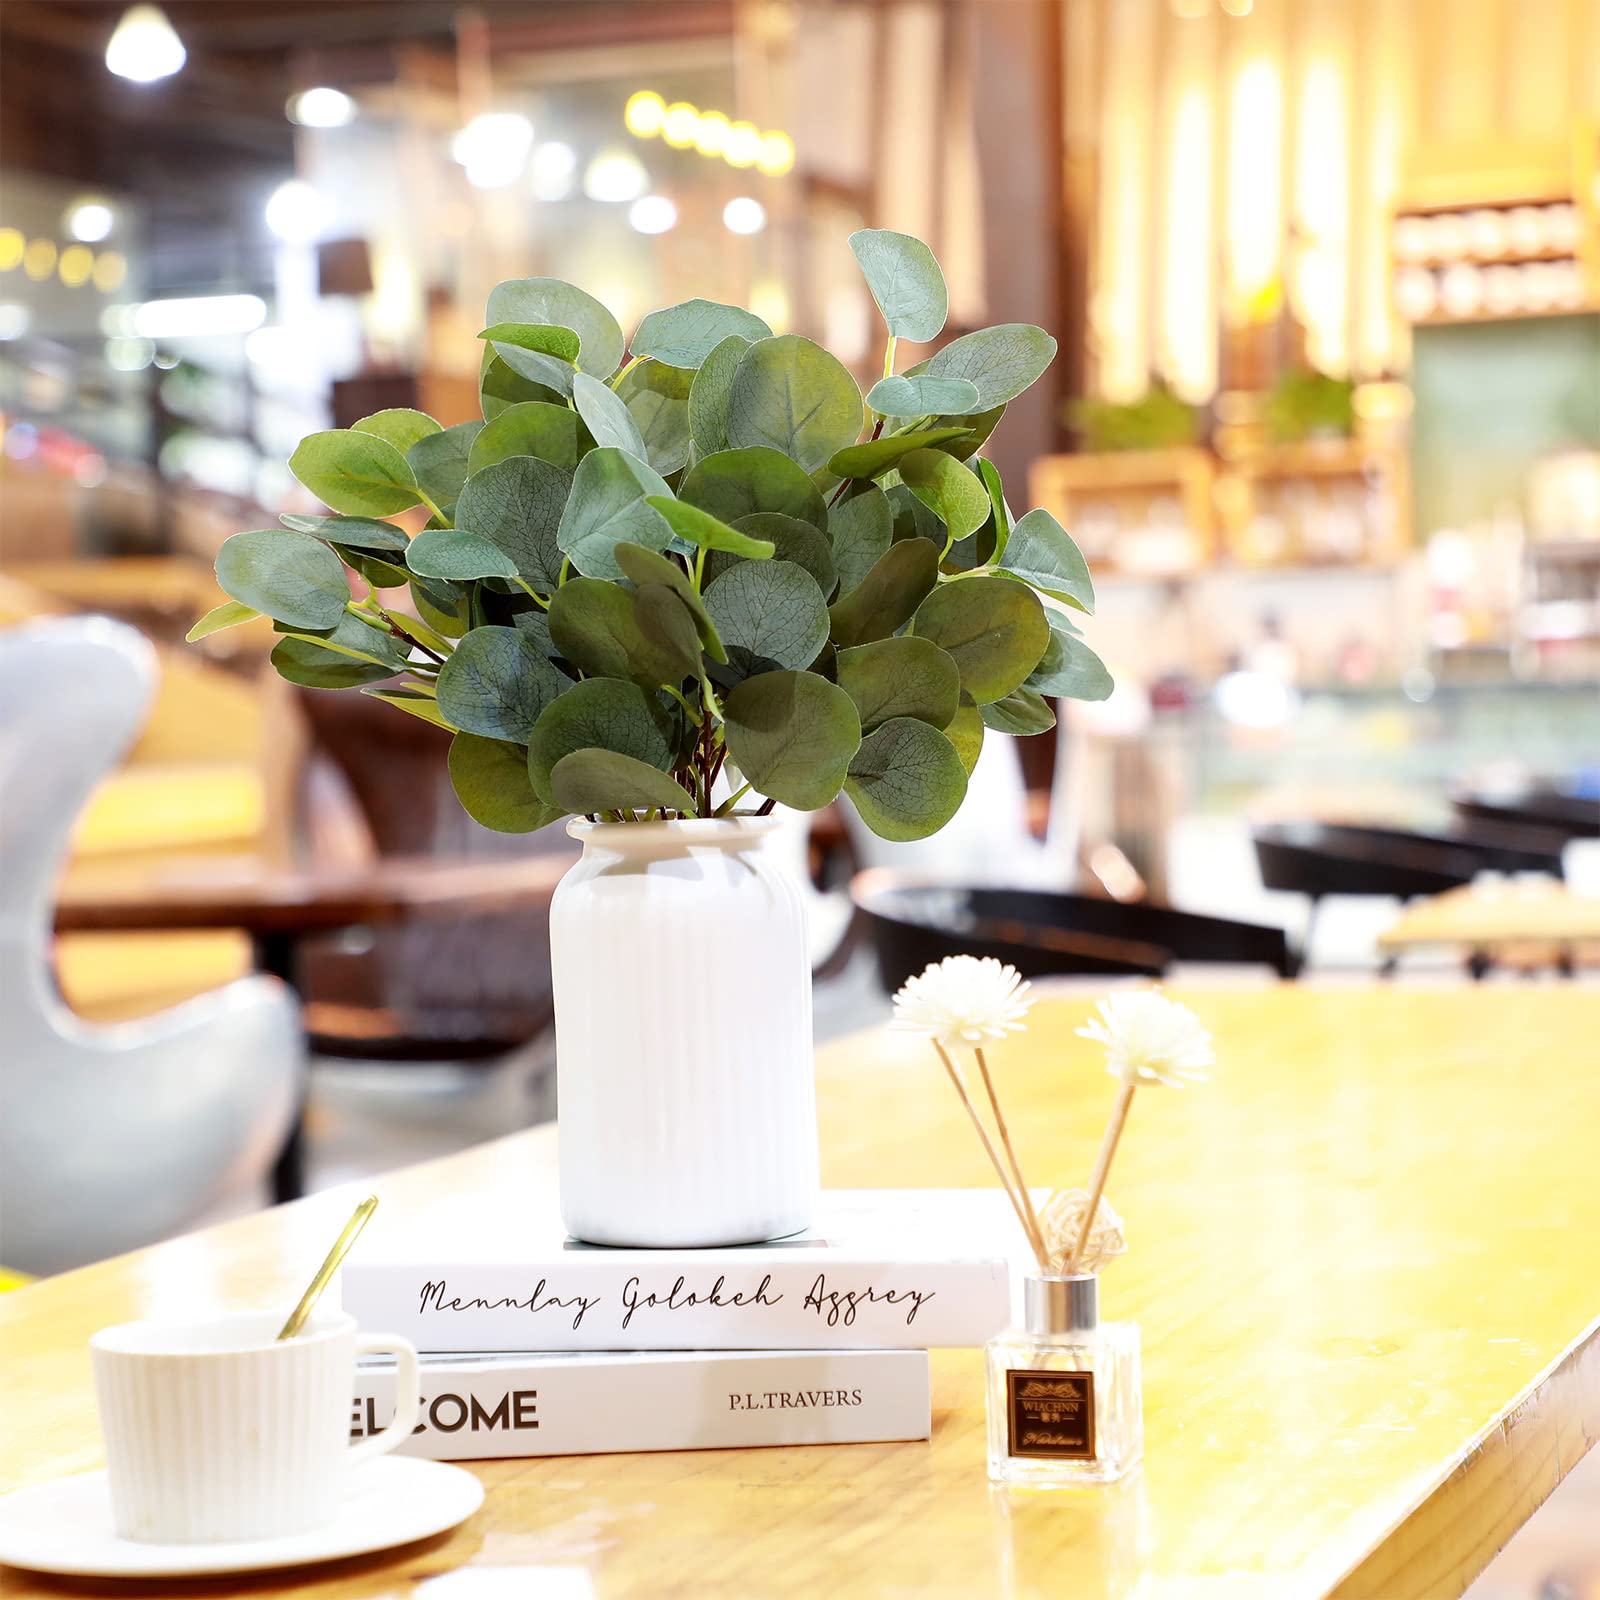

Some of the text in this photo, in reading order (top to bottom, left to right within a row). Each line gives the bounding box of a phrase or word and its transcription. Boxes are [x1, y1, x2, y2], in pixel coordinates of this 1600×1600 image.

[419, 1273, 936, 1330] Mennlay Golokeh Aggrey
[729, 1390, 862, 1411] P.L.TRAVERS
